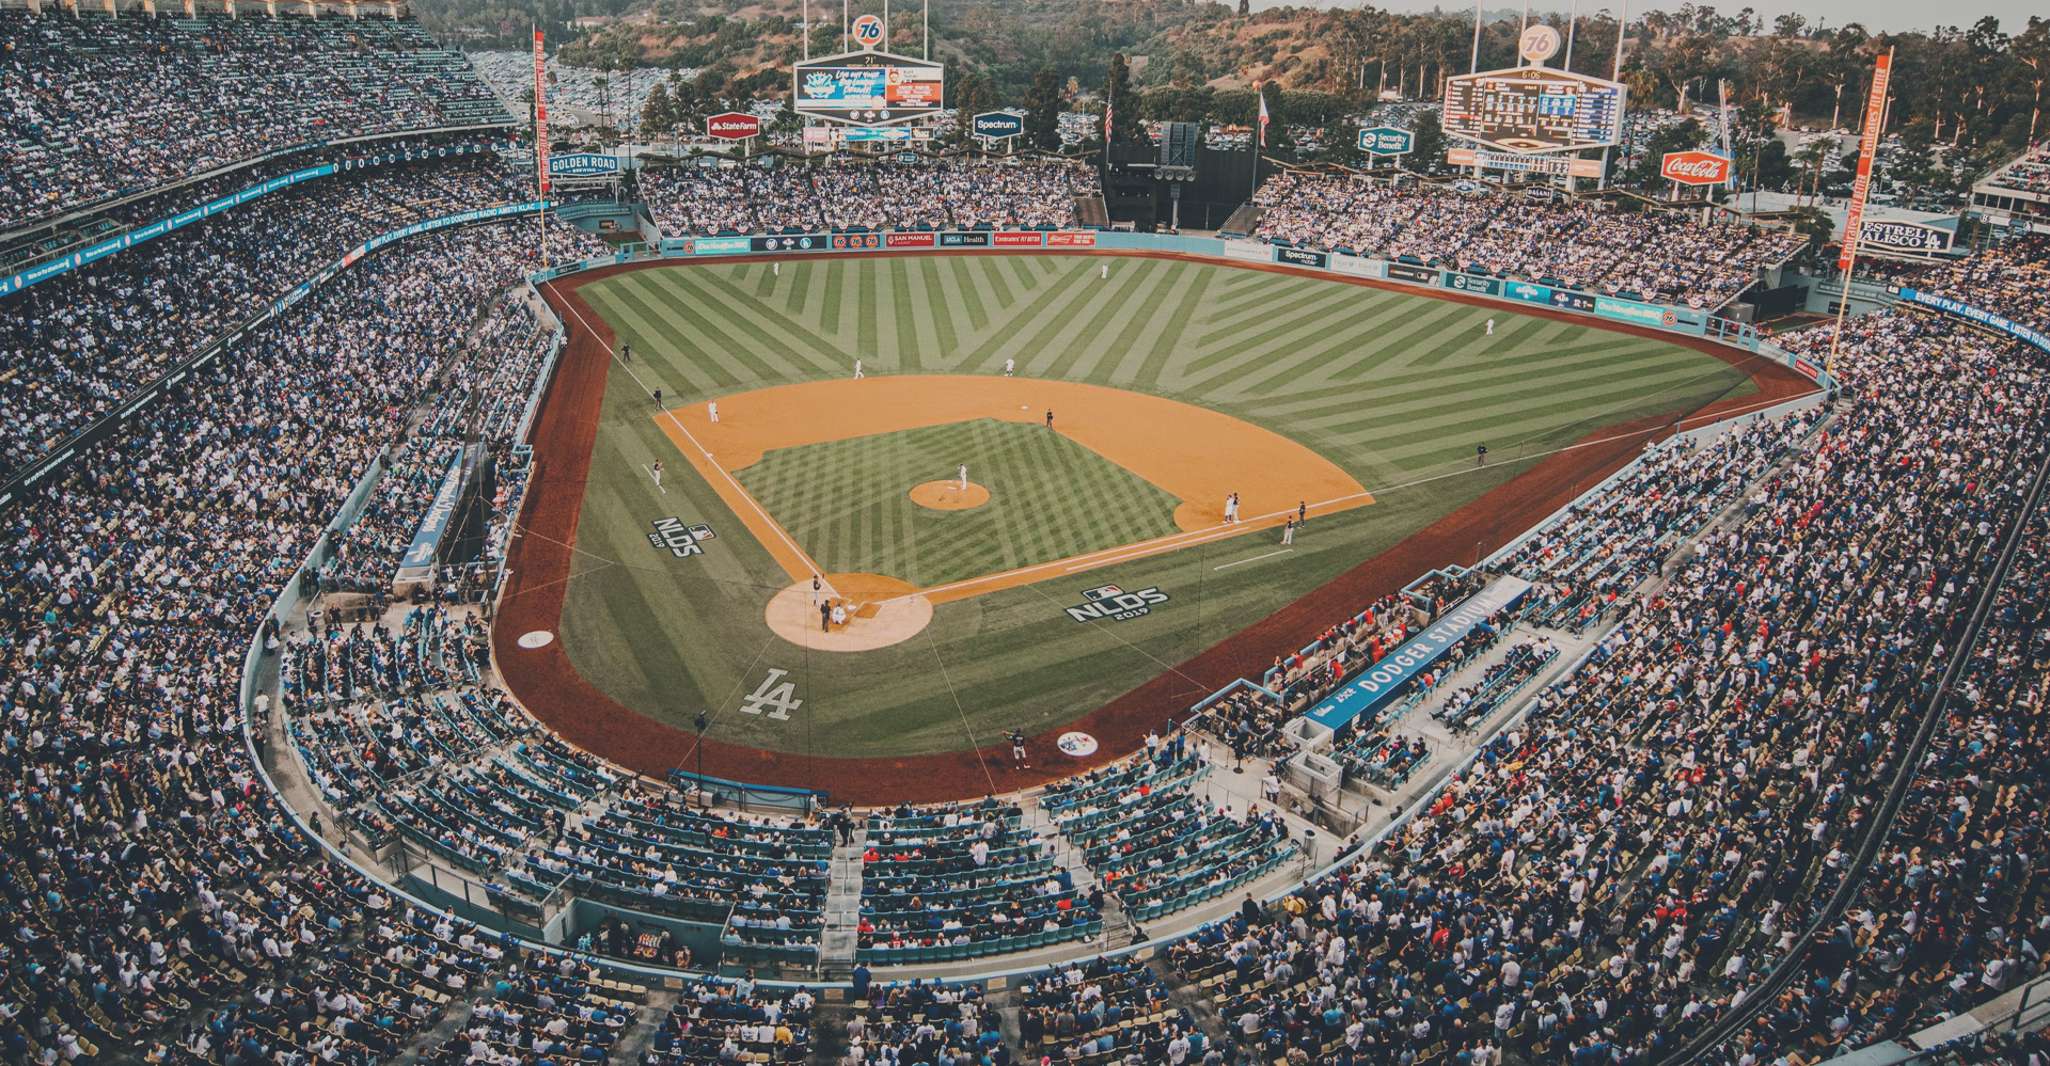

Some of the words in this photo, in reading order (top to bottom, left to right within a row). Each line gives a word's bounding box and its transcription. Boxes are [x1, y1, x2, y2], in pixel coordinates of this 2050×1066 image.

[860, 22, 880, 39] 76
[1525, 34, 1549, 53] 76
[978, 120, 1016, 130] Spectrum
[1378, 133, 1406, 144] Security
[1862, 110, 1879, 158] Emirates
[1378, 141, 1402, 150] Benefit
[552, 156, 588, 171] GOLDEN
[591, 155, 615, 169] ROAD
[1528, 189, 1550, 197] DASANI
[479, 208, 497, 218] RADIO
[1841, 216, 1859, 260] Emirates
[1285, 250, 1316, 260] Spectrum
[1467, 279, 1490, 288] Security
[1467, 284, 1486, 292] Benefit
[1916, 291, 1941, 307] EVERY
[1965, 305, 1989, 320] EVERY
[2010, 322, 2032, 340] LISTEN
[648, 533, 666, 548] 2019
[653, 517, 702, 557] NLDS
[1066, 588, 1169, 622] NLDS
[1114, 607, 1148, 621] 2019
[1358, 641, 1435, 692] DODGER
[1429, 594, 1499, 643] STADIUM
[739, 668, 803, 721] LA
